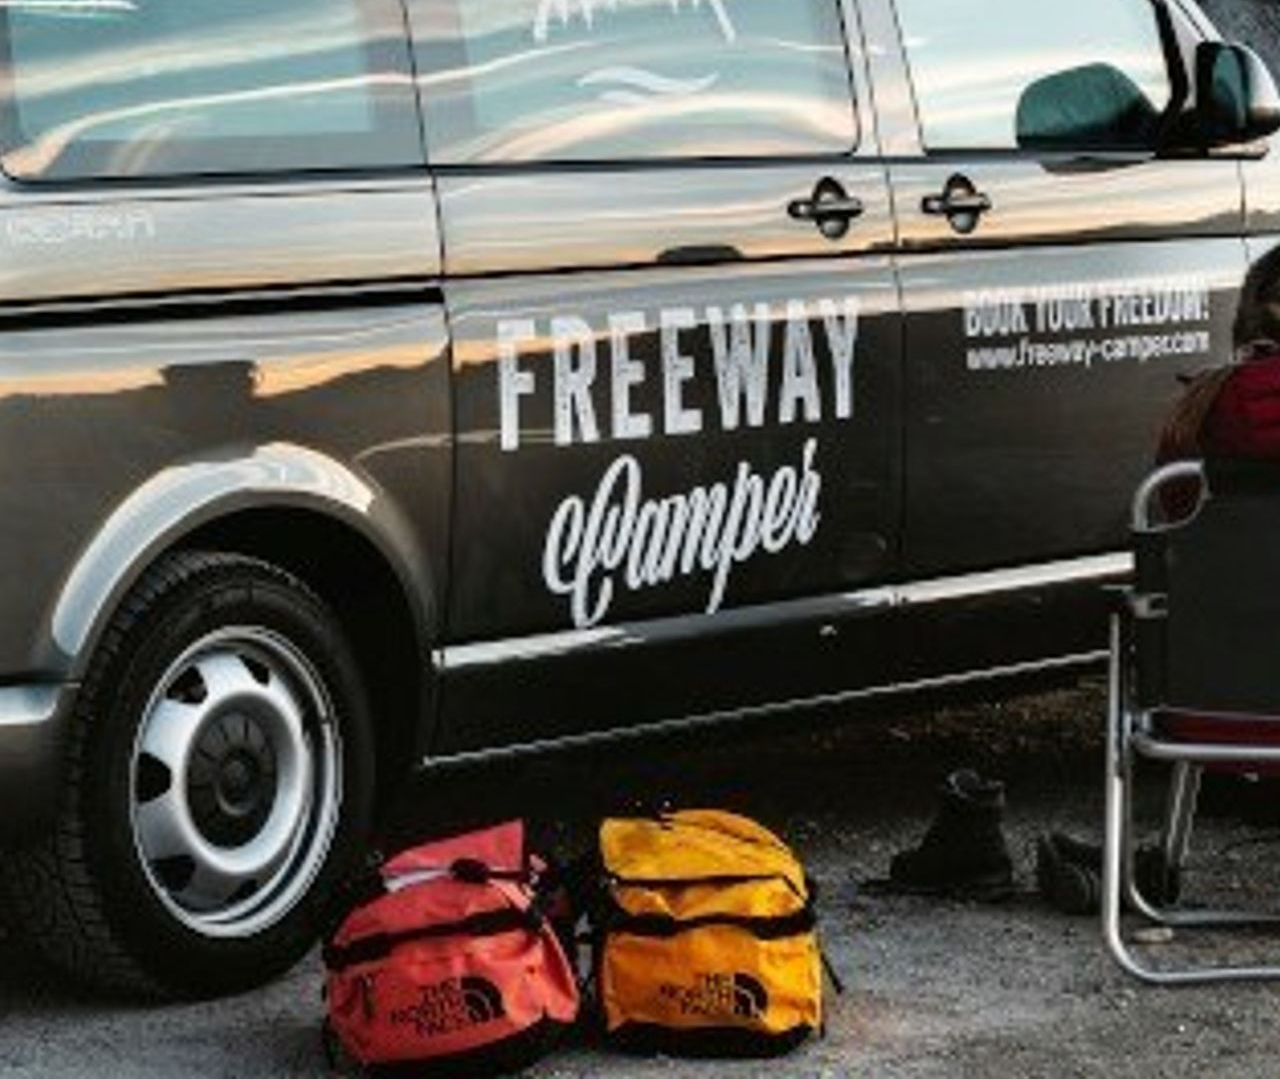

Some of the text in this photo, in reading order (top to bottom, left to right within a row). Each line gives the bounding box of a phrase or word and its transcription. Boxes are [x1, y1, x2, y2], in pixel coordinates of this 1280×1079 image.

[964, 276, 1210, 338] BOOK YOUR FREEDOM!
[966, 330, 1210, 371] www.freeway-camper.com
[496, 295, 862, 453] FREEWAY
[542, 437, 821, 628] Camper
